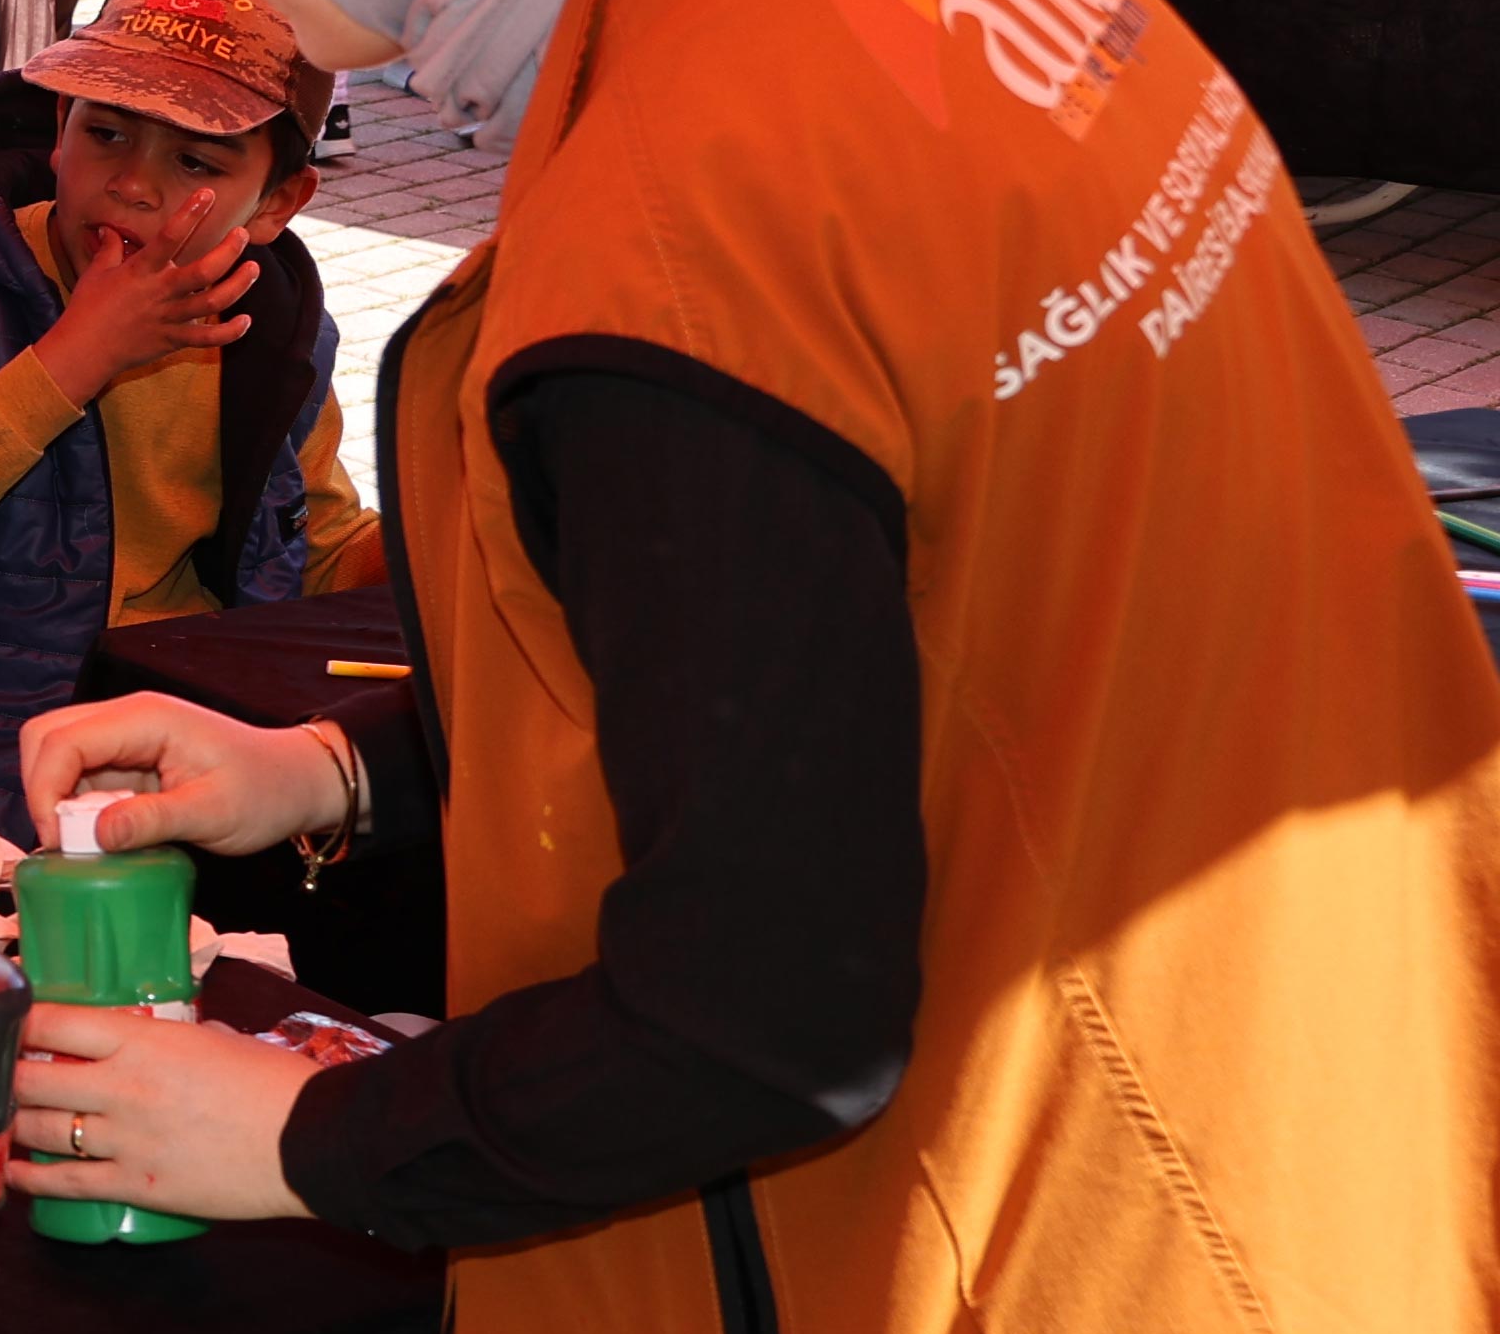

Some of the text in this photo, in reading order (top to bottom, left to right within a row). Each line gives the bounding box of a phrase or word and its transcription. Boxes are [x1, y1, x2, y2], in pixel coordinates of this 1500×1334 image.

[121, 9, 236, 60] TÜRKİYE
[993, 232, 1156, 402] SAĞLIK
[1132, 191, 1187, 255] VE
